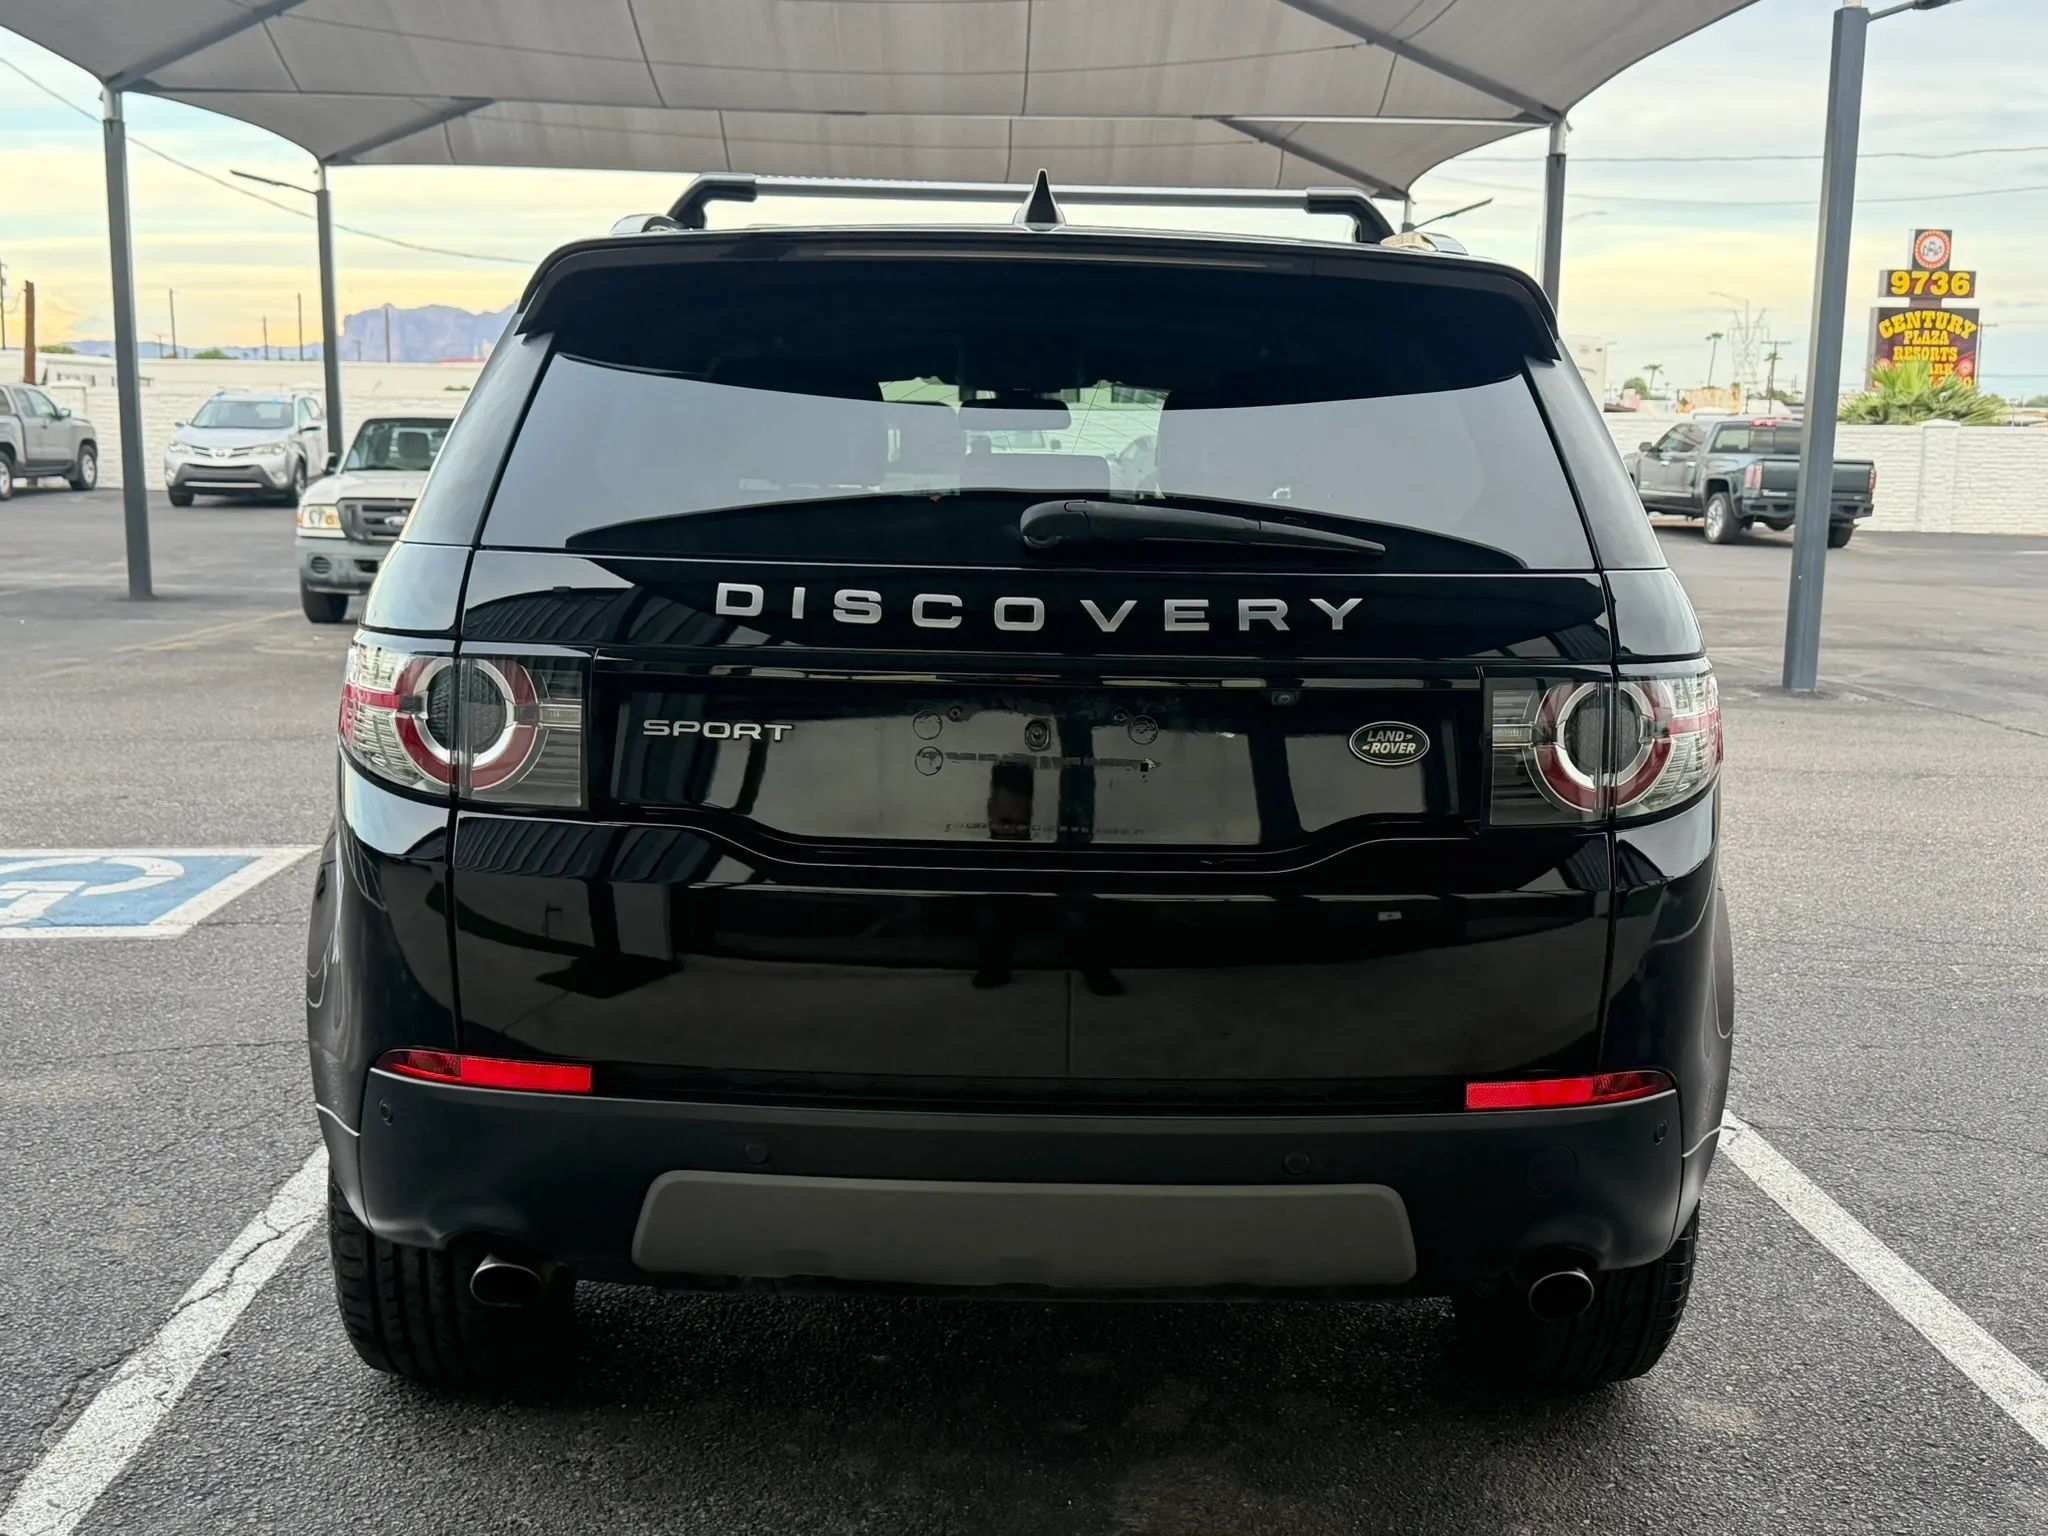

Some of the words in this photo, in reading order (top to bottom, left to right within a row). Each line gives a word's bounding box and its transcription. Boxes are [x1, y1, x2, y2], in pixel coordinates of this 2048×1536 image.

[1890, 271, 1970, 296] 9736
[1879, 311, 1977, 339] CENTURY
[1904, 330, 1949, 345] PLAZA
[1894, 347, 1958, 362] RESORTS
[715, 583, 1363, 633] DISCOVERY
[643, 719, 793, 741] SPORT
[1367, 731, 1405, 742] LAND
[1370, 742, 1416, 754] ROVER
